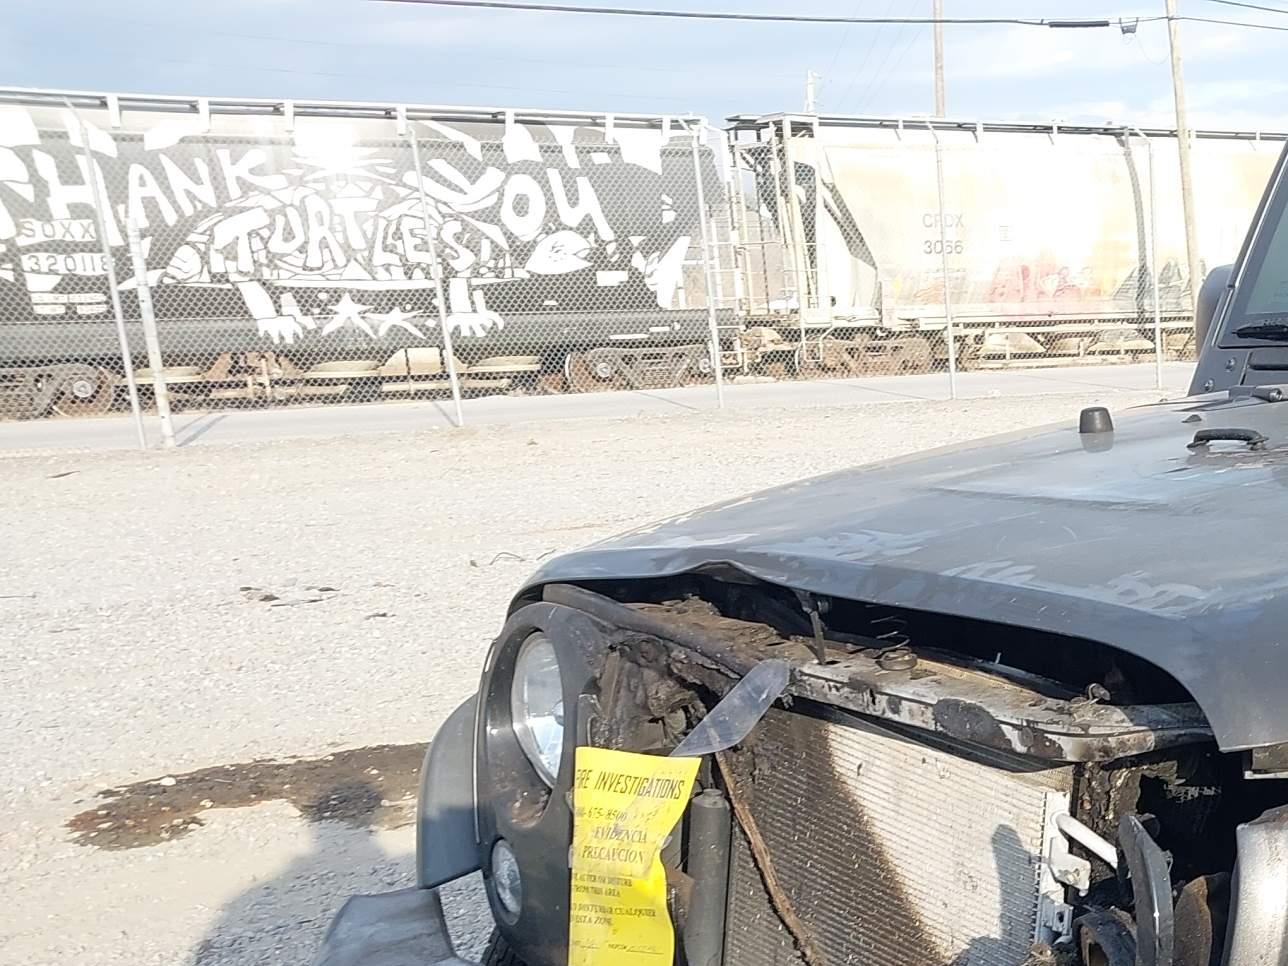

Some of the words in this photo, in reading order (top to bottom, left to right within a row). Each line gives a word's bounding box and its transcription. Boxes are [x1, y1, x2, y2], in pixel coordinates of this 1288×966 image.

[402, 157, 616, 242] YOU
[20, 220, 97, 239] SOXX
[27, 254, 113, 274] 320118
[594, 770, 685, 800] INVESTIGATIONS
